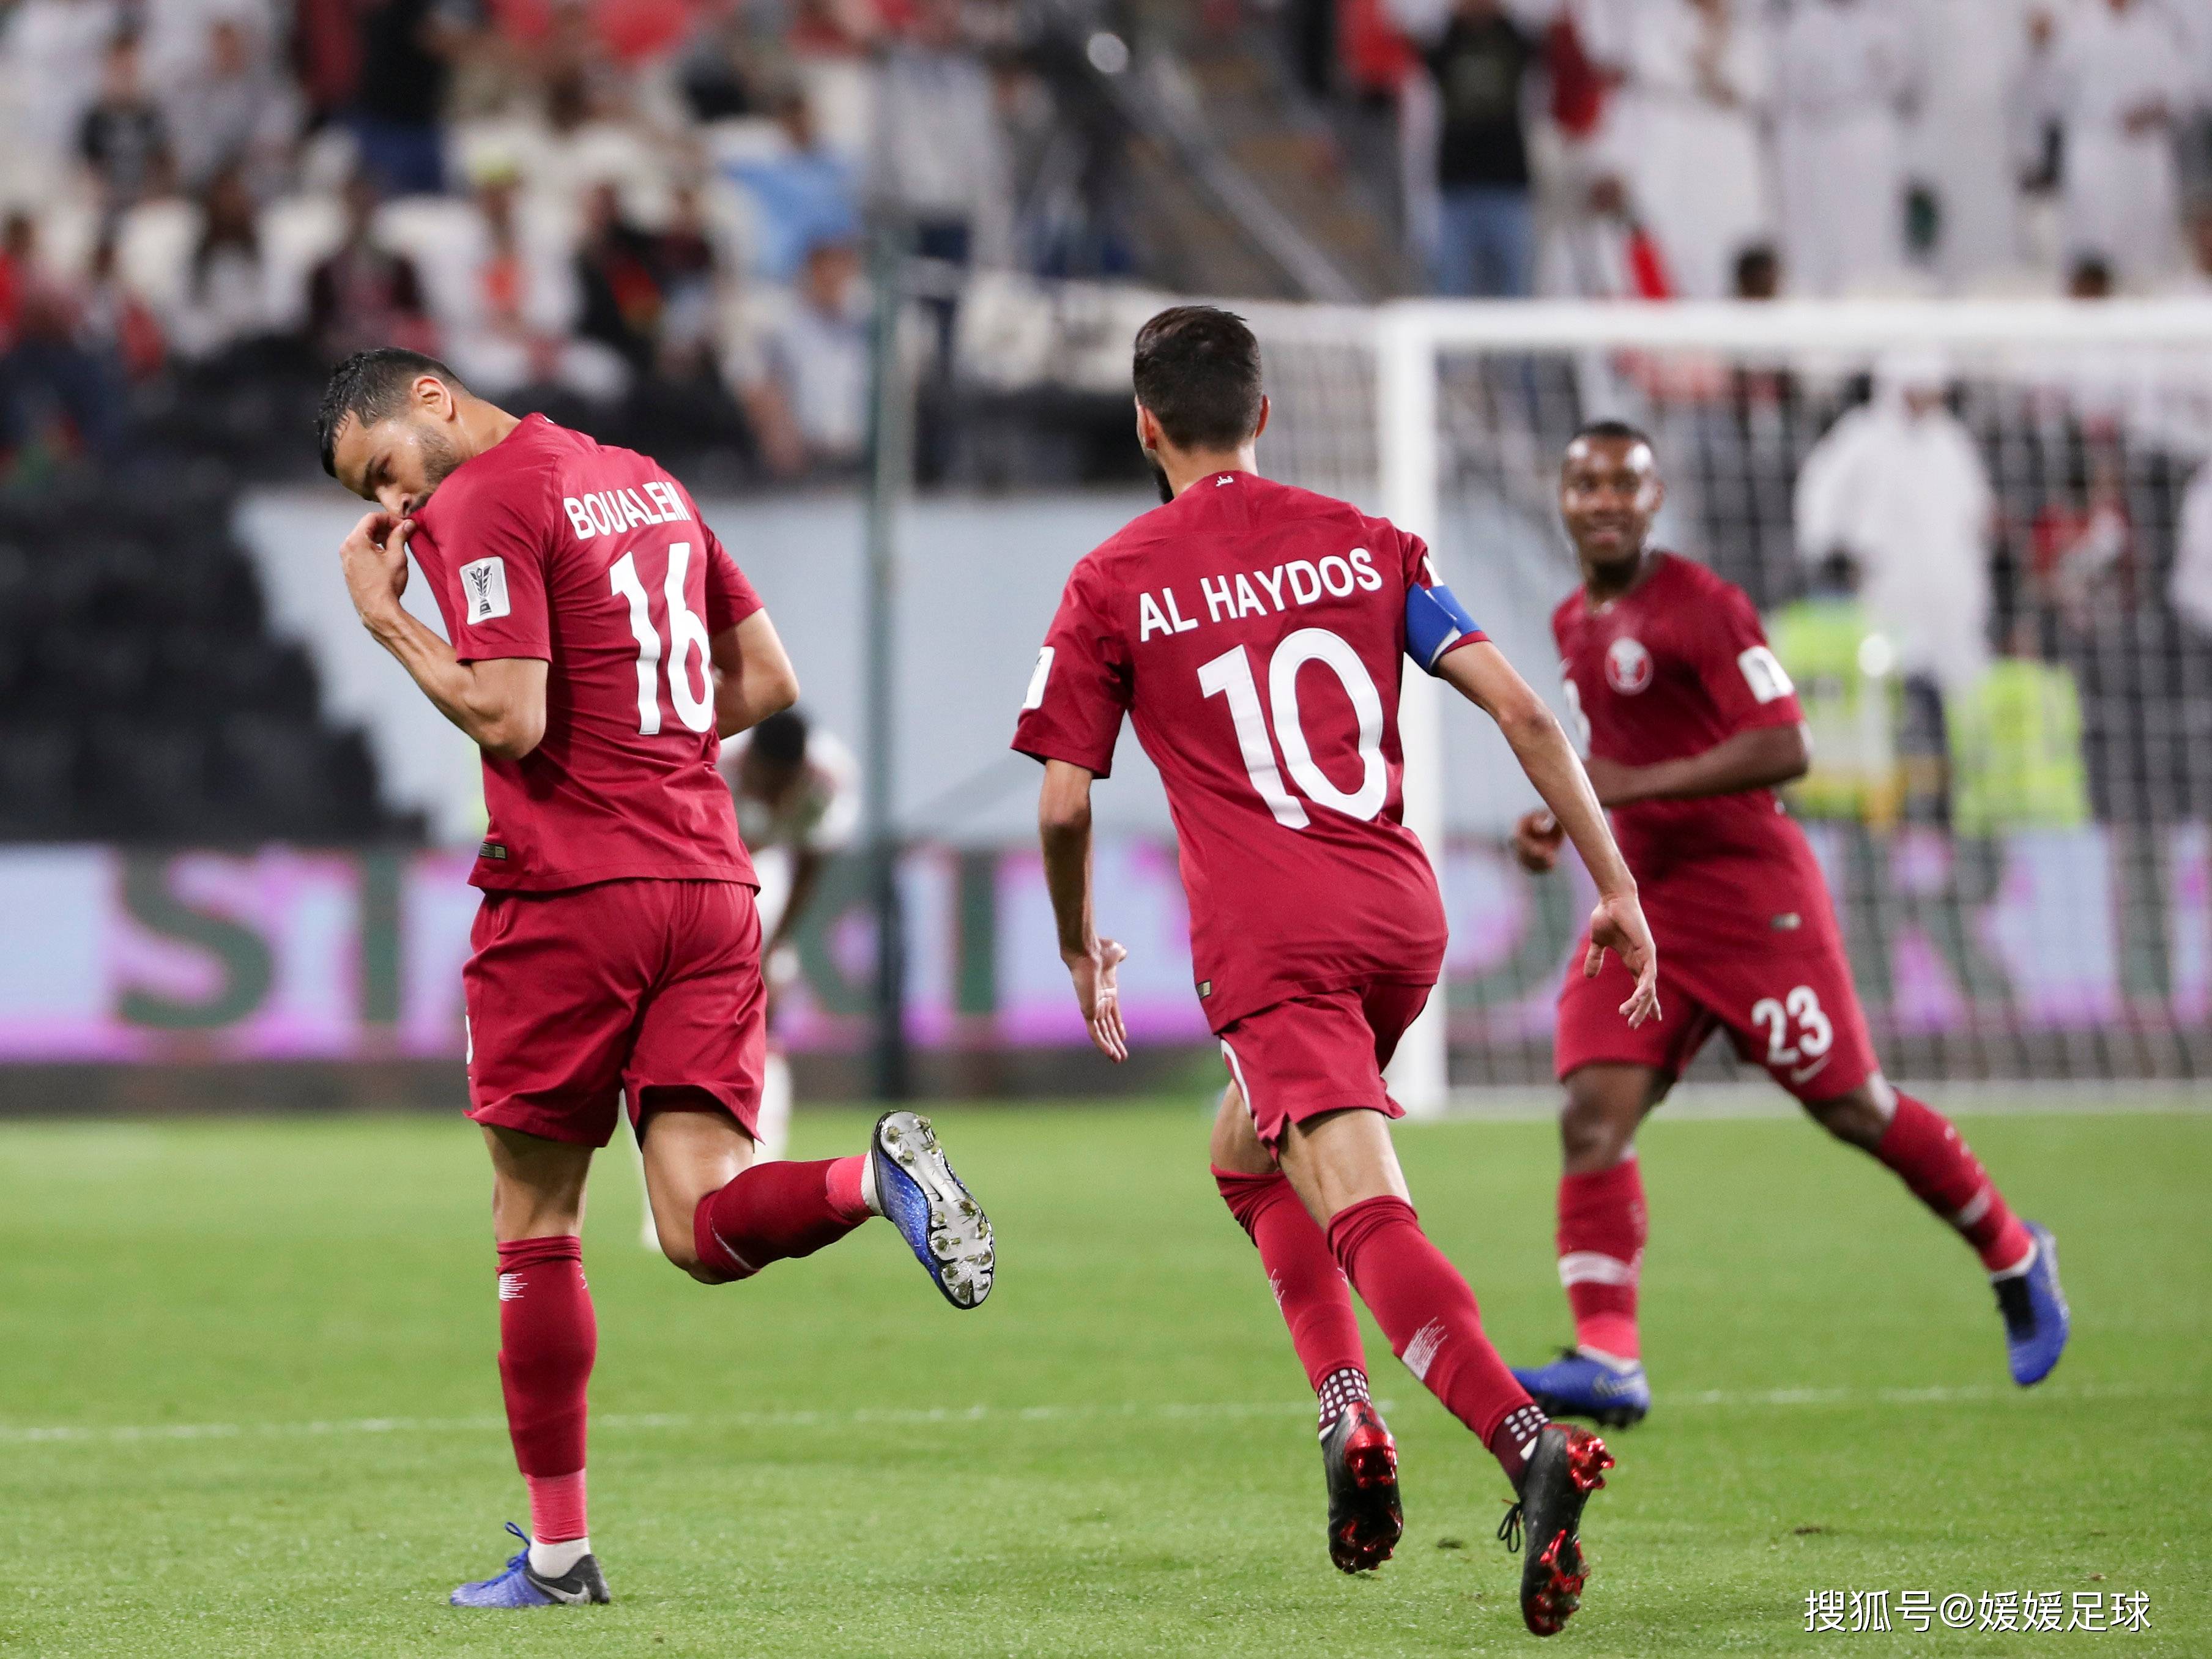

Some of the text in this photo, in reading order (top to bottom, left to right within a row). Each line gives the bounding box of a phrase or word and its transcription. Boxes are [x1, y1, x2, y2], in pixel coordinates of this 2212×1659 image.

[609, 541, 716, 735] 16
[1140, 547, 1382, 642] AL HAYDOS
[1196, 627, 1388, 830] 10
[1752, 985, 1833, 1063] 23
